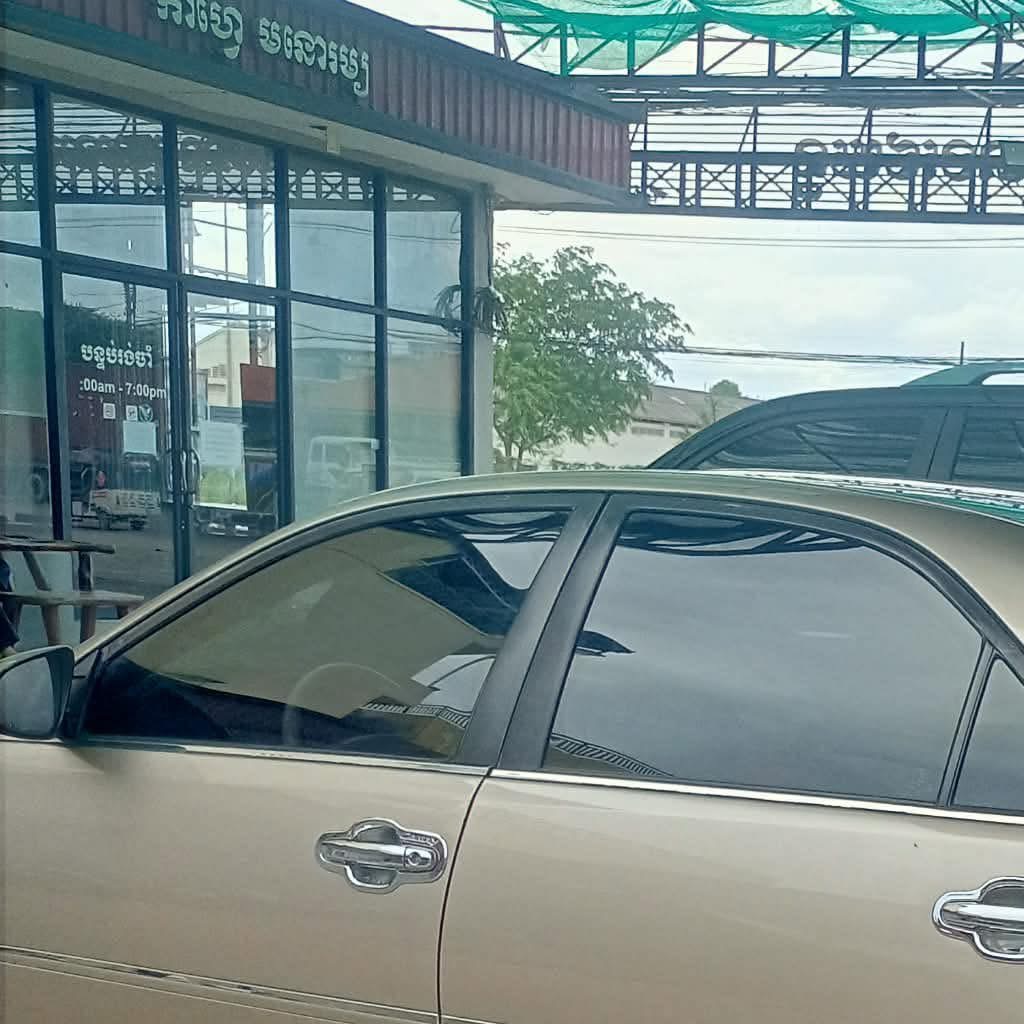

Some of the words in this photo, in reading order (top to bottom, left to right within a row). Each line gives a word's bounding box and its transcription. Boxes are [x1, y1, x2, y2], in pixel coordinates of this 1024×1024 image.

[80, 339, 153, 371] បន្ទប់រង់ចាំ
[125, 381, 167, 401] 7:00pm
